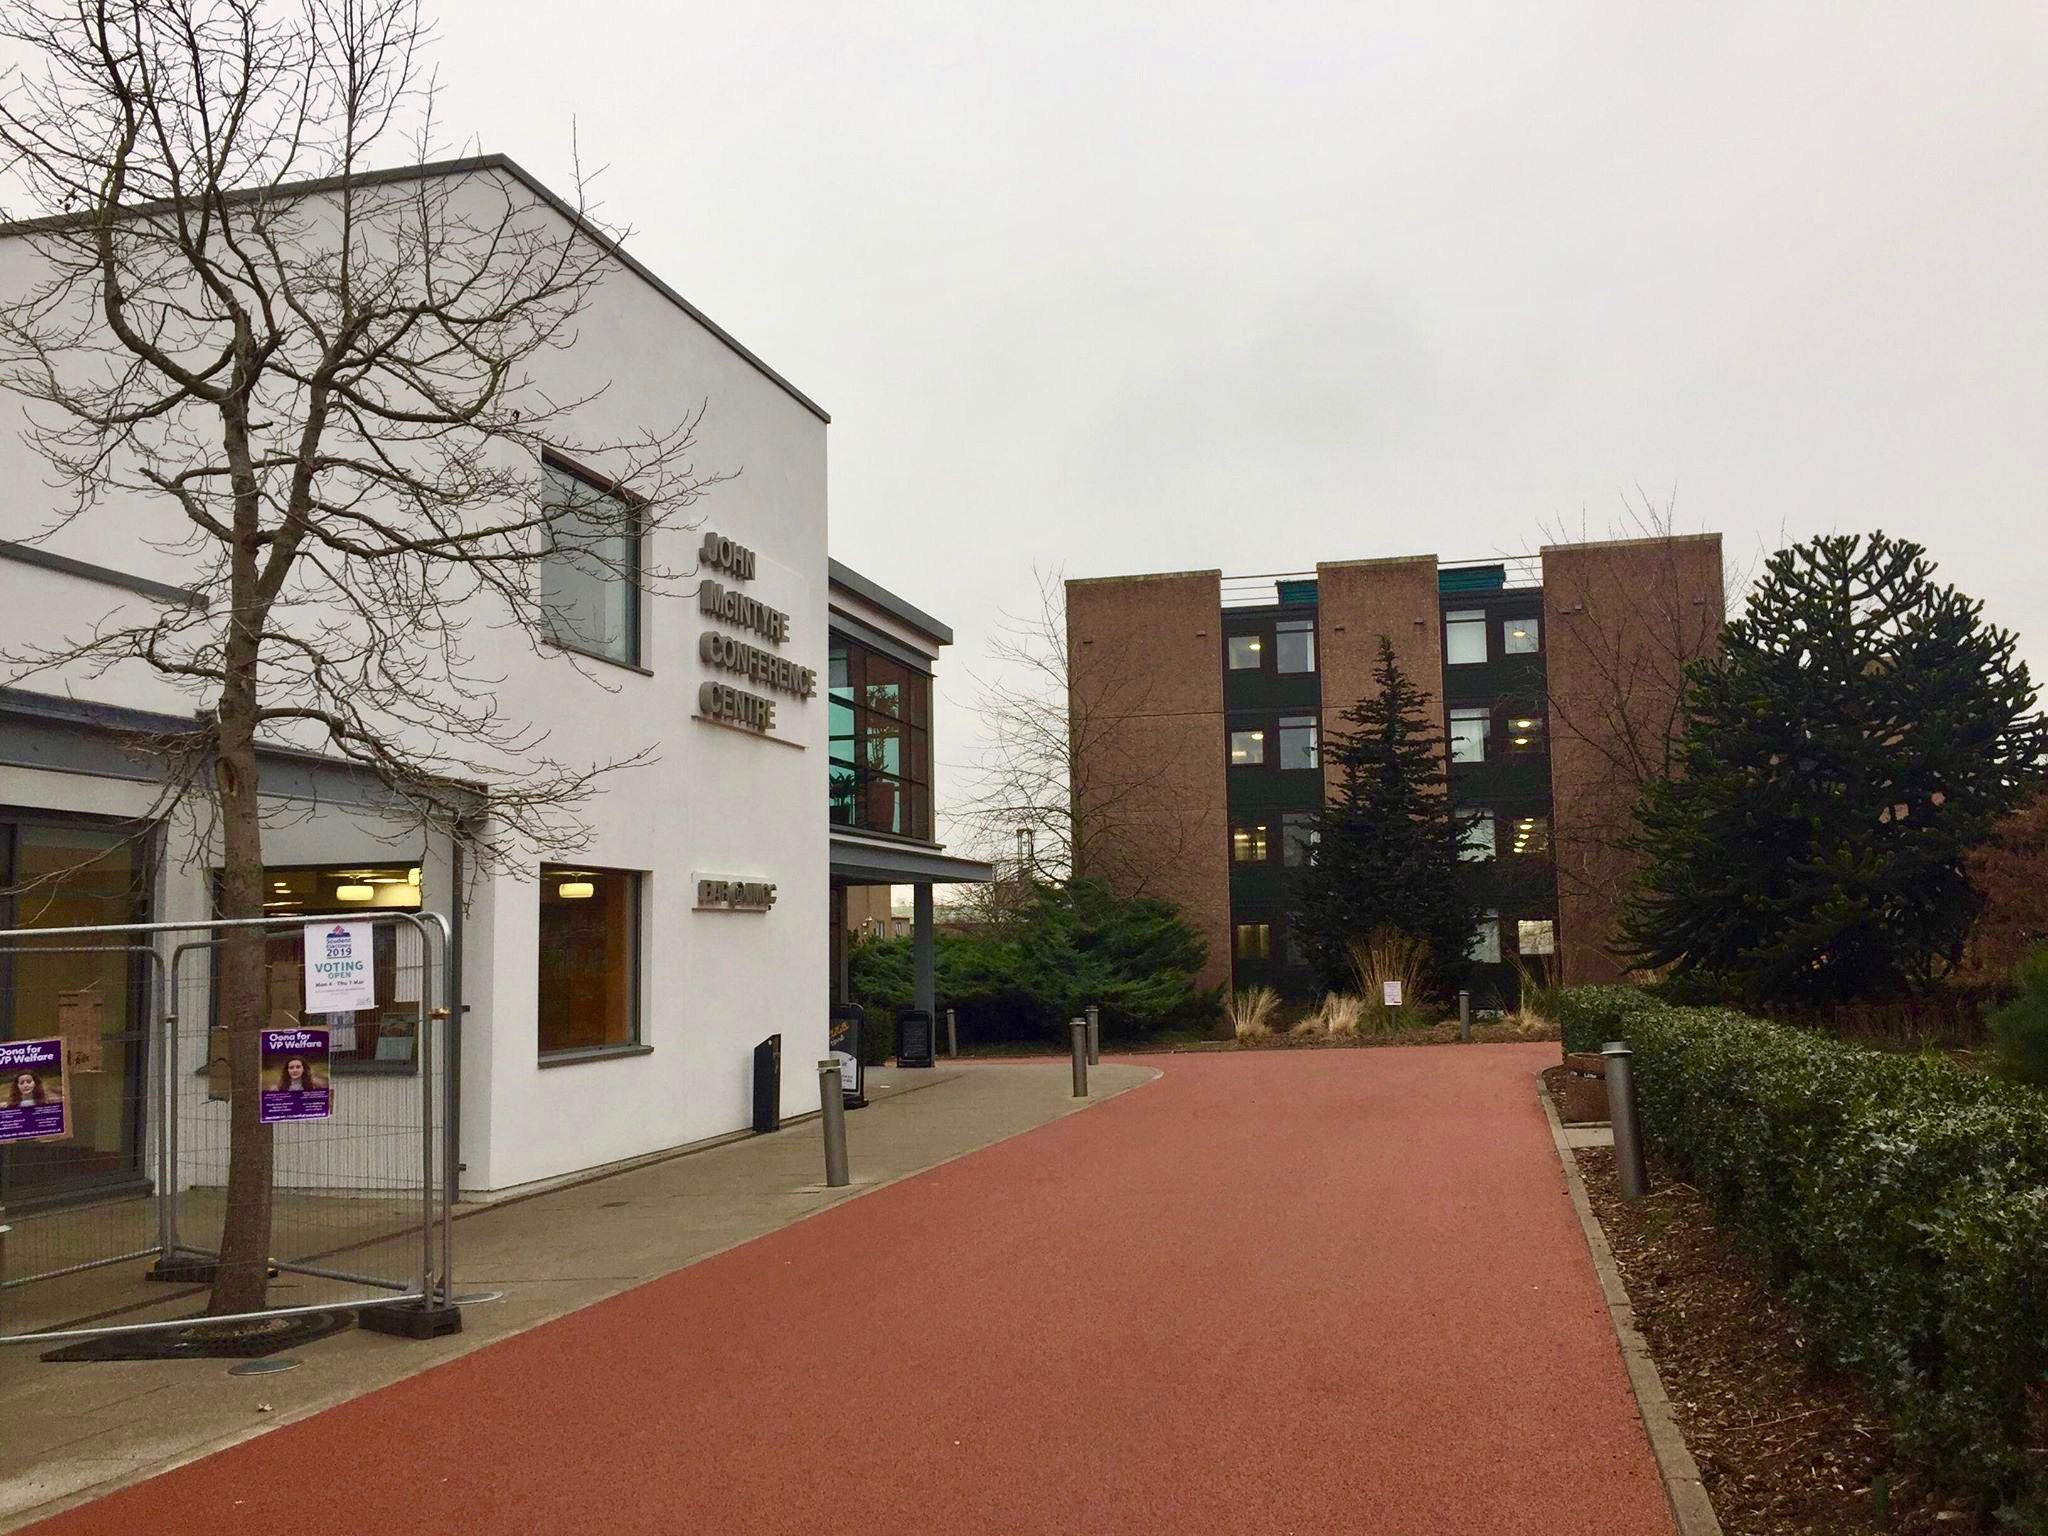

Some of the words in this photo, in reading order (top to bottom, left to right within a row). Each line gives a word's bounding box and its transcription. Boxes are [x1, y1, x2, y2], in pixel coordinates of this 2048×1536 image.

[699, 532, 756, 581] JOHN
[701, 580, 790, 643] McINTYRE
[700, 631, 817, 698] CONFERENCE
[700, 681, 776, 732] CENTRE
[327, 947, 352, 957] 2019
[315, 961, 363, 973] VOTING
[296, 1031, 311, 1040] for
[26, 1044, 42, 1054] for
[269, 1041, 283, 1050] VP
[285, 1040, 322, 1048] Welfare
[13, 1053, 54, 1063] Welfare
